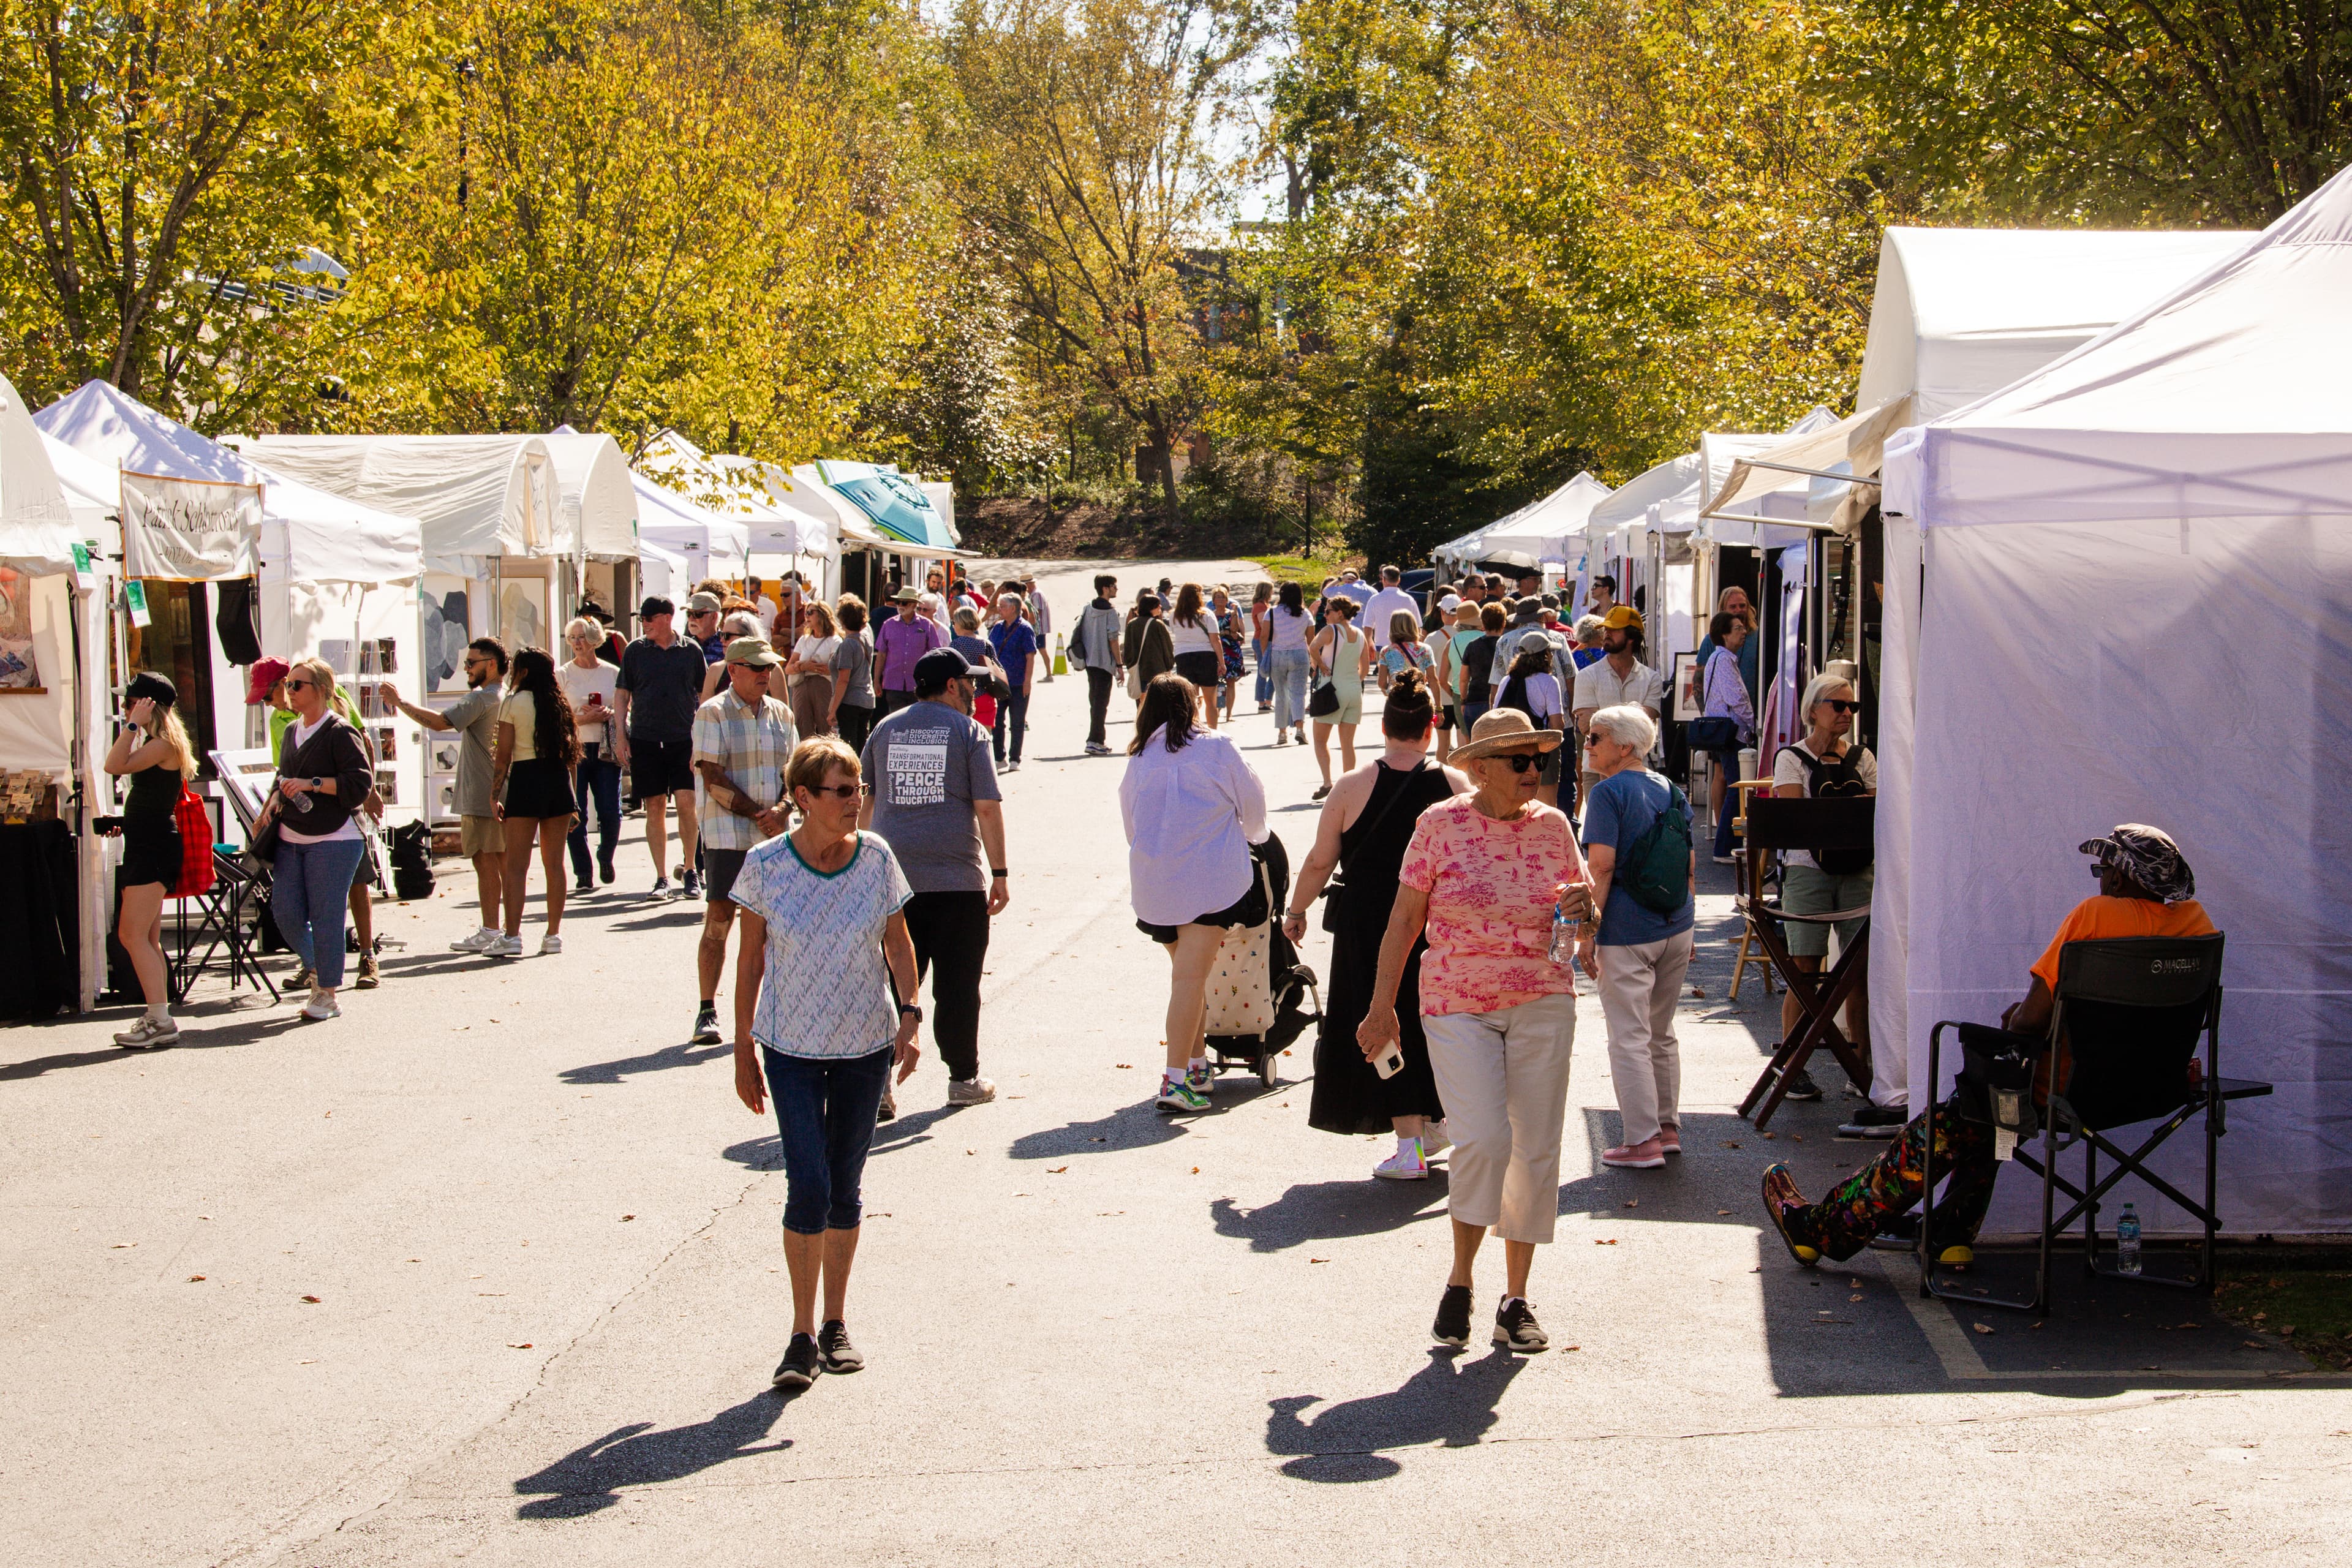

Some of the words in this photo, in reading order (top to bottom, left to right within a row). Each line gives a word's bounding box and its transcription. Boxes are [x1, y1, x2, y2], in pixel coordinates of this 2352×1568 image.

[889, 760, 943, 770] EXPERIENCES
[895, 772, 945, 786] PEACE
[895, 786, 944, 796] THROUGH
[895, 794, 944, 805] EDUCATION
[2164, 957, 2200, 970] MAGELLAN
